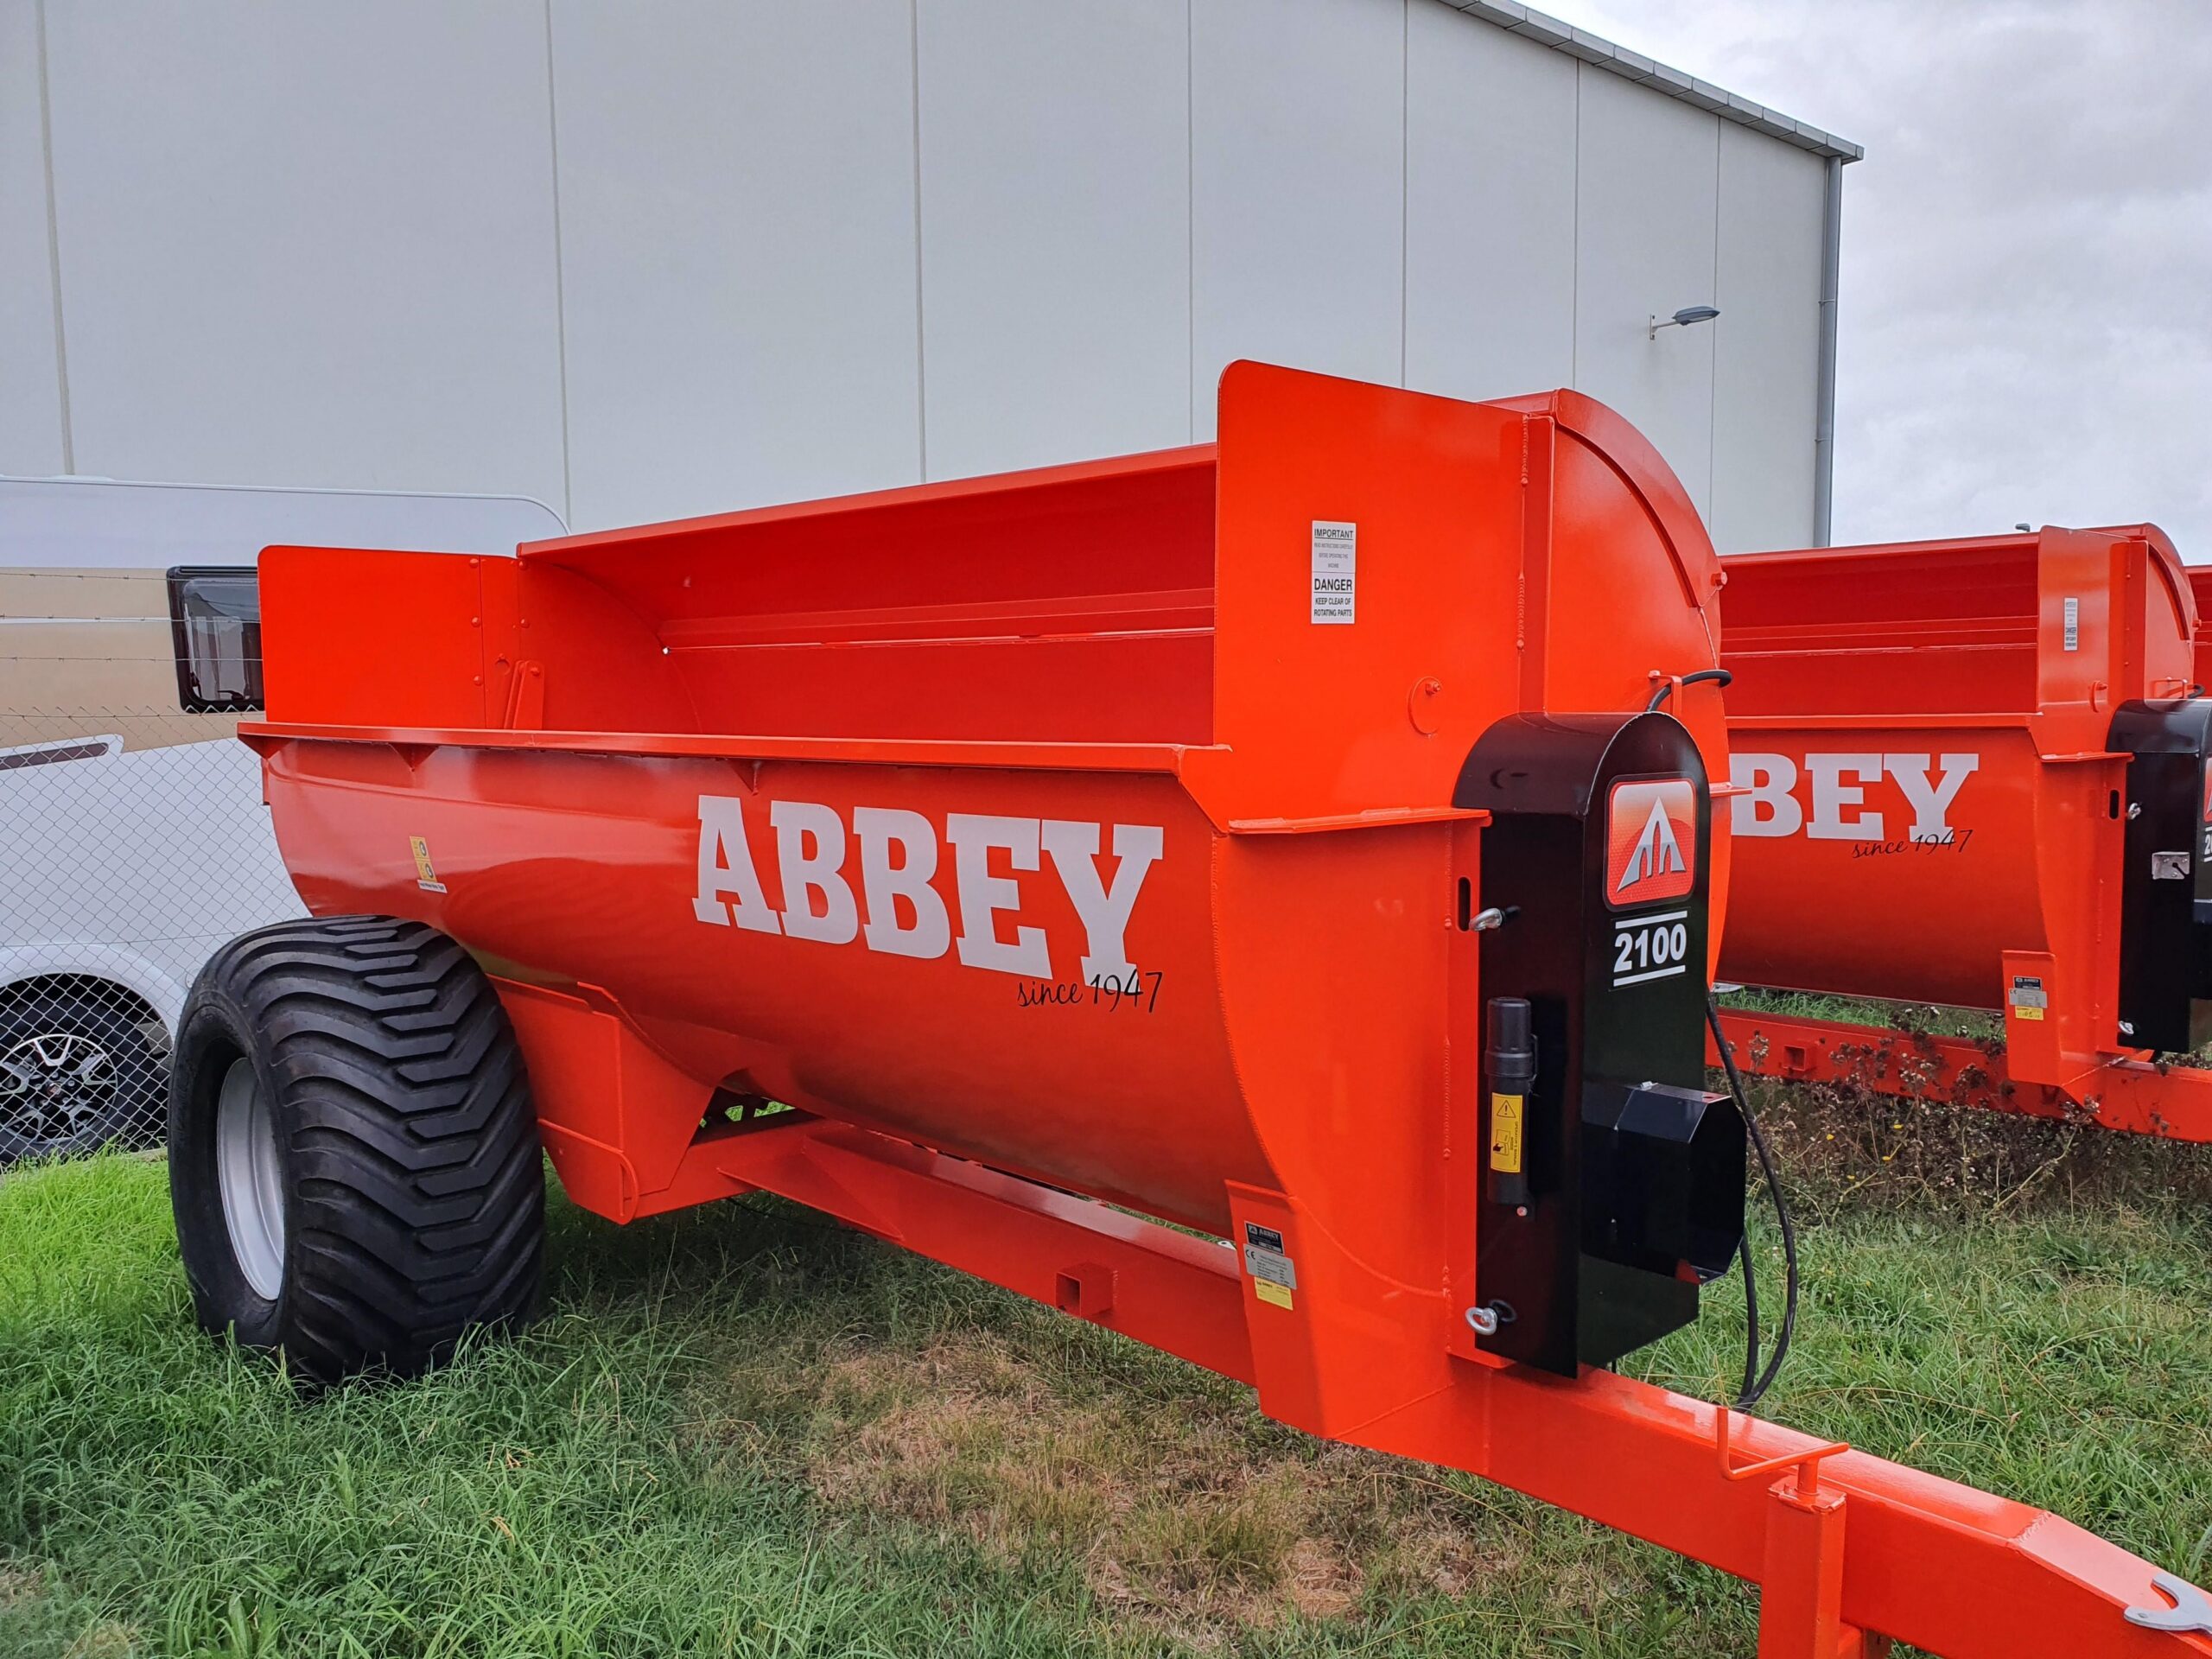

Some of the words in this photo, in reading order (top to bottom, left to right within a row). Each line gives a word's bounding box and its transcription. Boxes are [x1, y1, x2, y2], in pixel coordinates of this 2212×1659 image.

[1314, 528, 1353, 538] IMPORTANT
[1314, 578, 1352, 591] DANGER
[1852, 839, 1908, 859] since
[1914, 830, 1974, 855] 1947
[691, 794, 1164, 994] ABBEY
[1613, 923, 1687, 973] 2100
[1017, 979, 1084, 1008] since
[1090, 969, 1164, 1014] 1947
